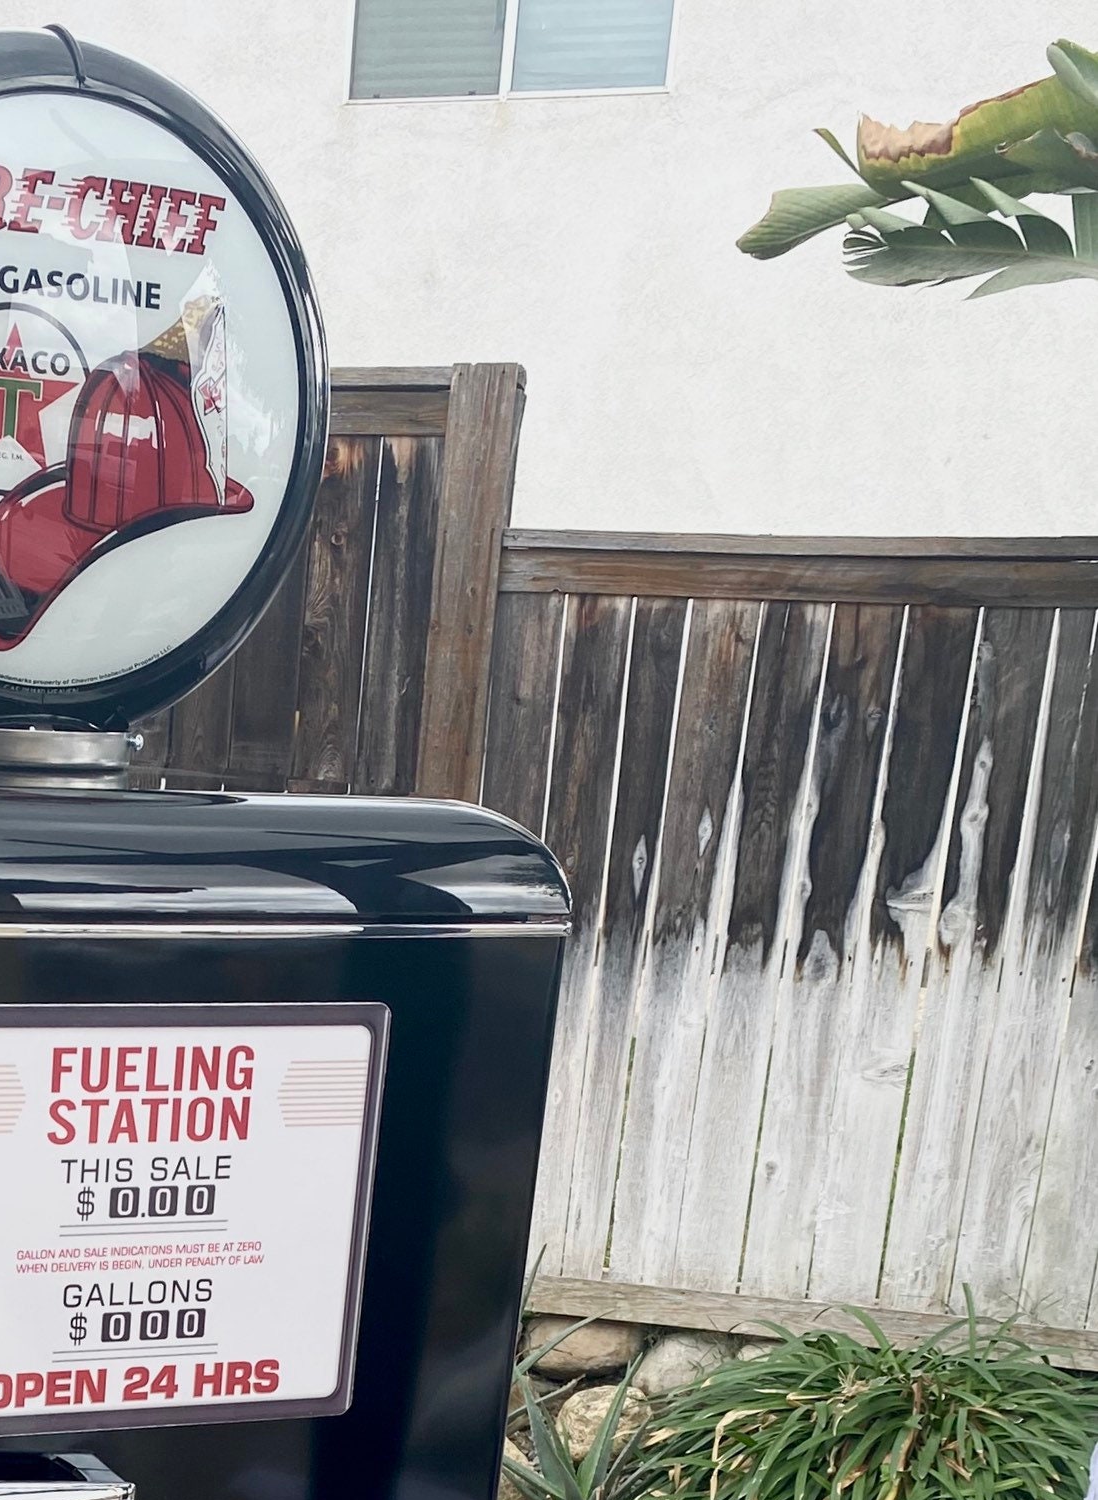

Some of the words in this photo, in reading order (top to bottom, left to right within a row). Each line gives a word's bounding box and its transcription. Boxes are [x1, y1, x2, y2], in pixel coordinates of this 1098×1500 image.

[50, 1045, 255, 1094] FUELING
[47, 1096, 252, 1145] STATION
[61, 1157, 134, 1184] THIS
[150, 1155, 232, 1182] SALE
[76, 1186, 95, 1221] $
[16, 1249, 55, 1260] GALLON
[58, 1248, 80, 1259] AND
[84, 1246, 107, 1258] SALE
[111, 1244, 173, 1257] INDICATIONS
[175, 1243, 204, 1255] MUST
[207, 1242, 220, 1253] BE
[223, 1241, 235, 1252] AT
[237, 1240, 262, 1251] ZERO
[16, 1263, 48, 1274] WHEN
[51, 1261, 96, 1272] DELIVERY
[99, 1259, 109, 1270] IS
[148, 1256, 182, 1269] UNDER
[185, 1255, 226, 1267] PENALTY
[228, 1254, 241, 1265] OF
[243, 1253, 265, 1264] LAW
[62, 1278, 213, 1308] GALLONS
[69, 1312, 88, 1346] $
[123, 1365, 179, 1402] 24
[193, 1359, 280, 1397] HRS
